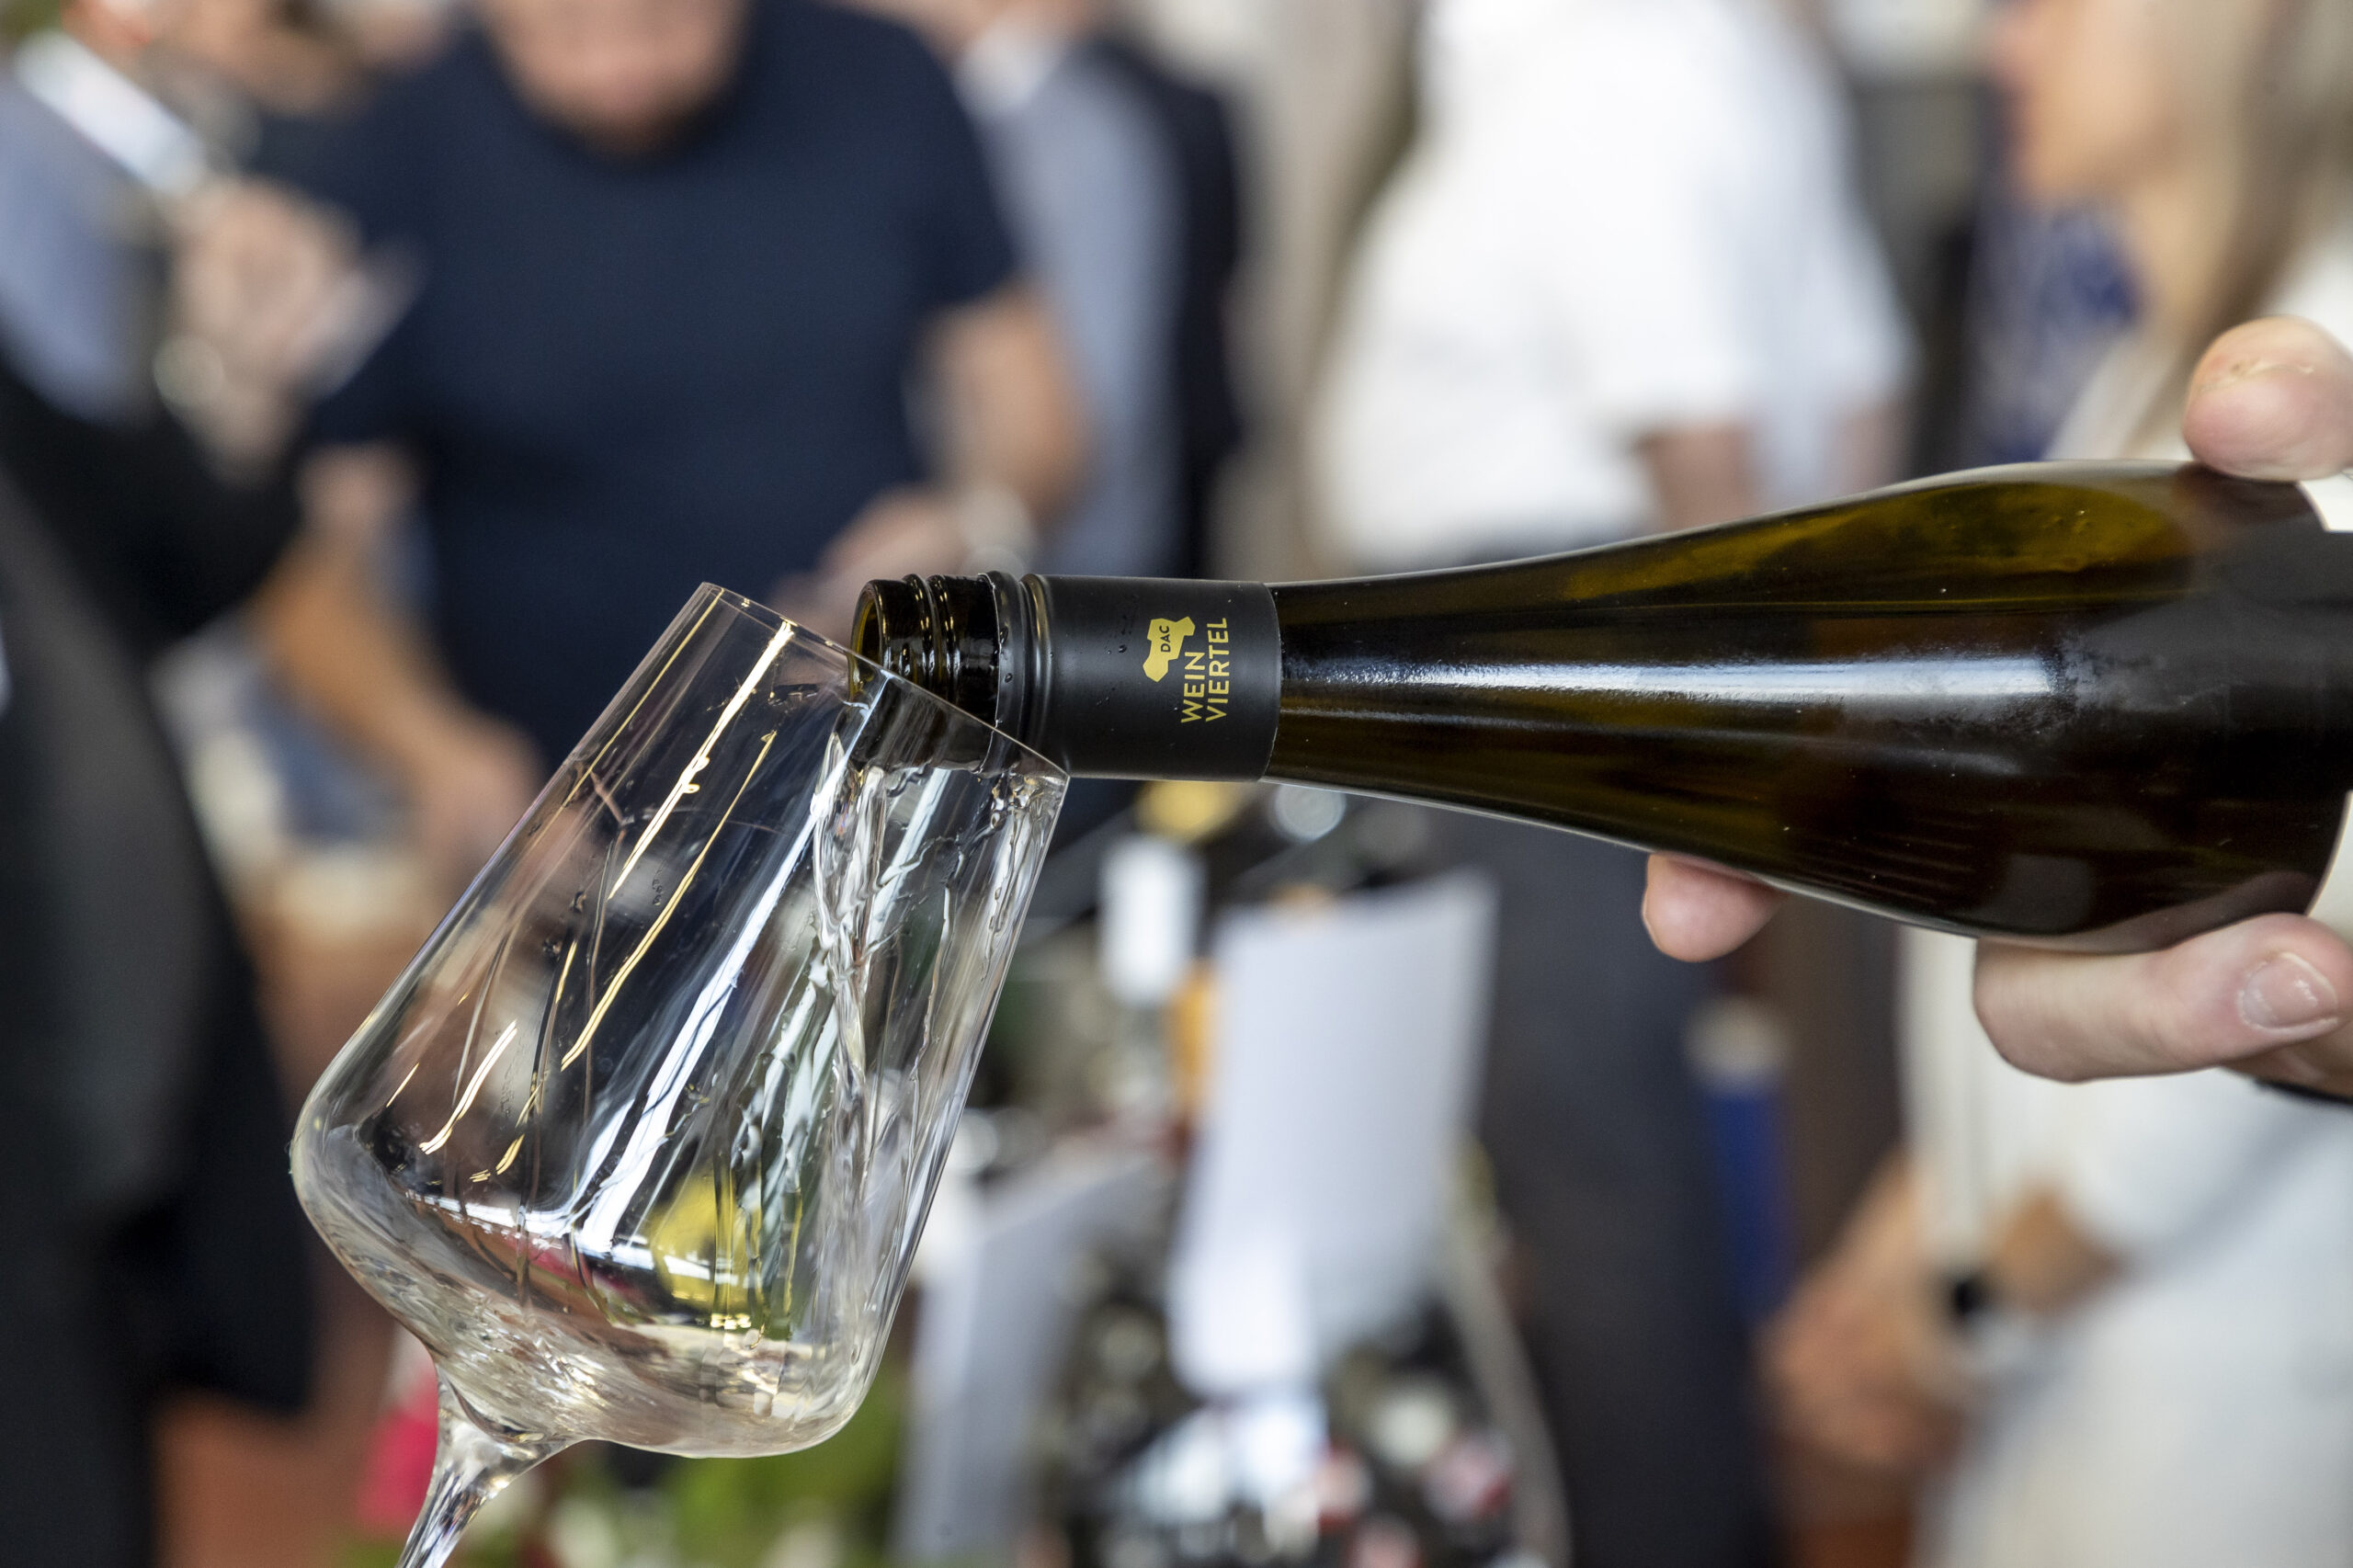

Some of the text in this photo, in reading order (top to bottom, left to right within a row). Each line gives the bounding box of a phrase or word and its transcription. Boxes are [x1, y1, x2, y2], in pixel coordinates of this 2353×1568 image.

[1159, 625, 1171, 653] DAC
[1205, 618, 1230, 722] VIERTEL
[1180, 652, 1206, 723] WEIN
